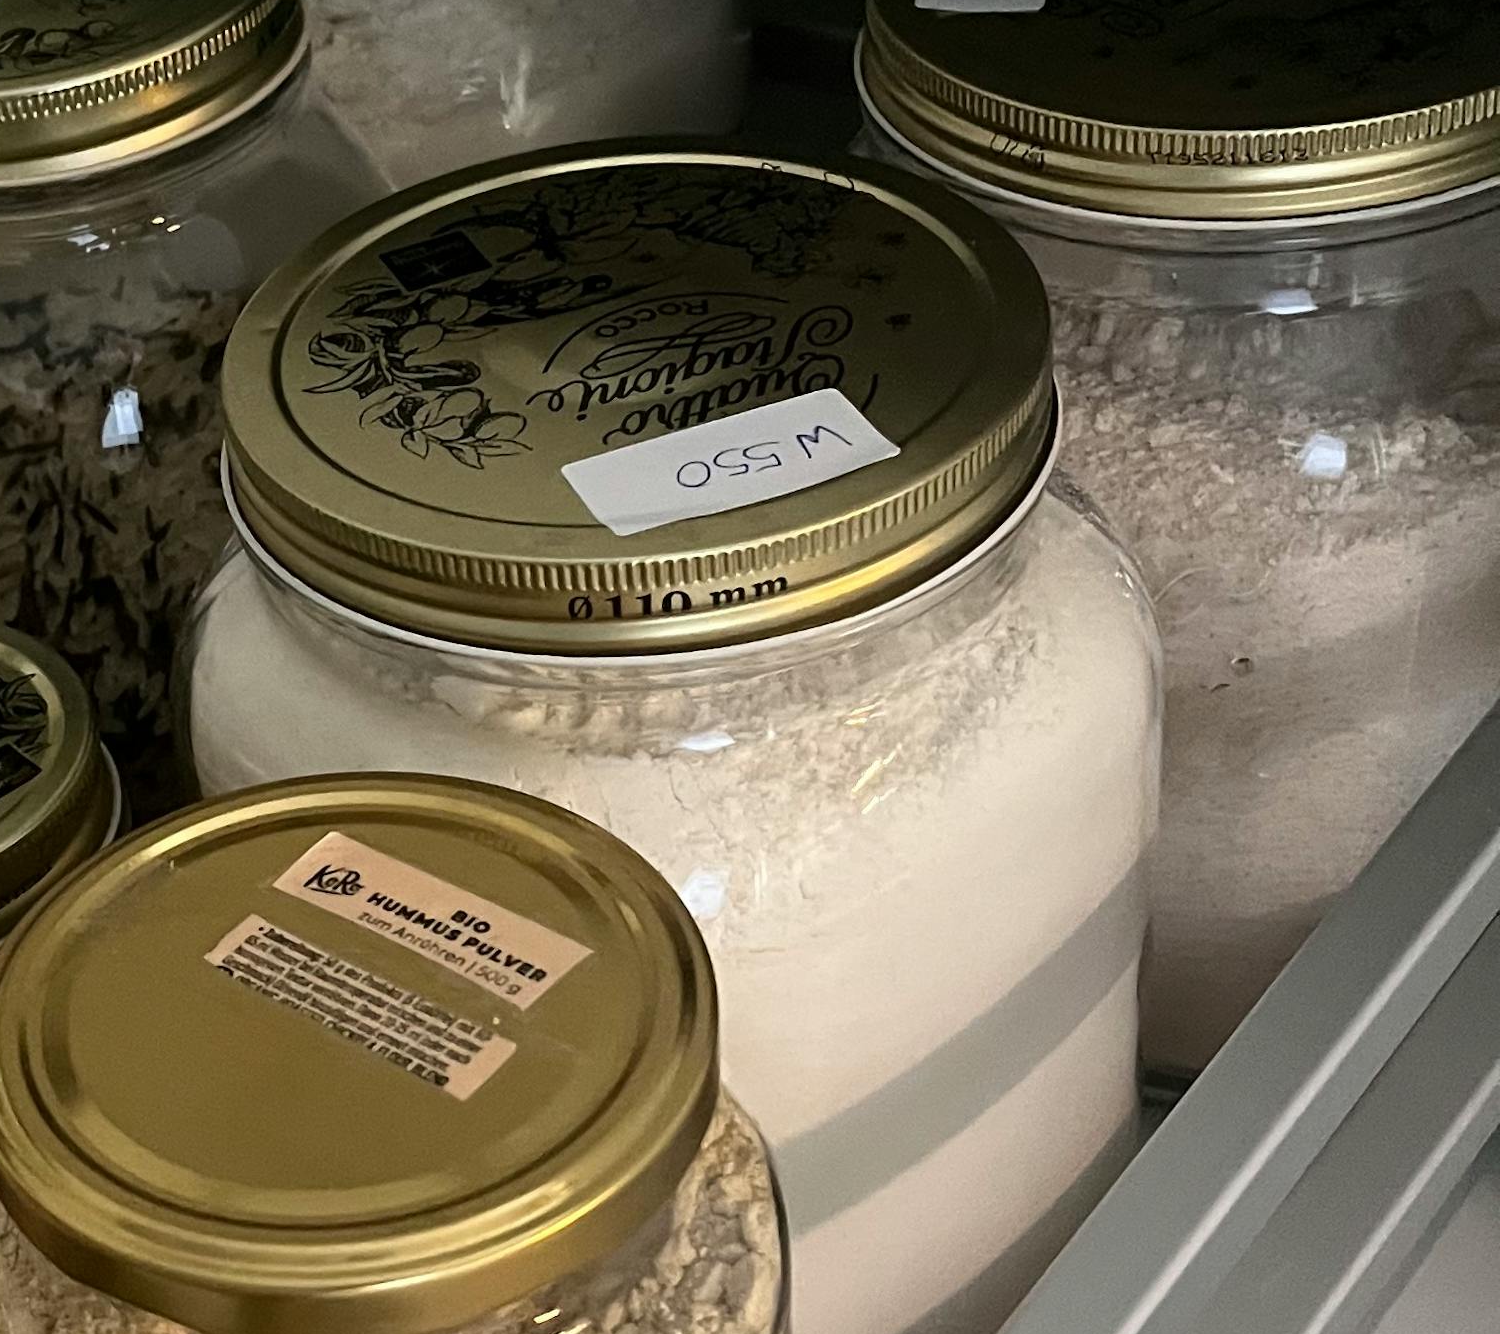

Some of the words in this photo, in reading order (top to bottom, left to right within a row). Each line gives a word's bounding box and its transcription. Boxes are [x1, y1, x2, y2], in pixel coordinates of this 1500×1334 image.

[796, 424, 853, 460] W
[676, 440, 783, 488] 550
[366, 892, 462, 942] HUMMUS
[461, 935, 548, 983] PULVER
[450, 909, 491, 934] BIO
